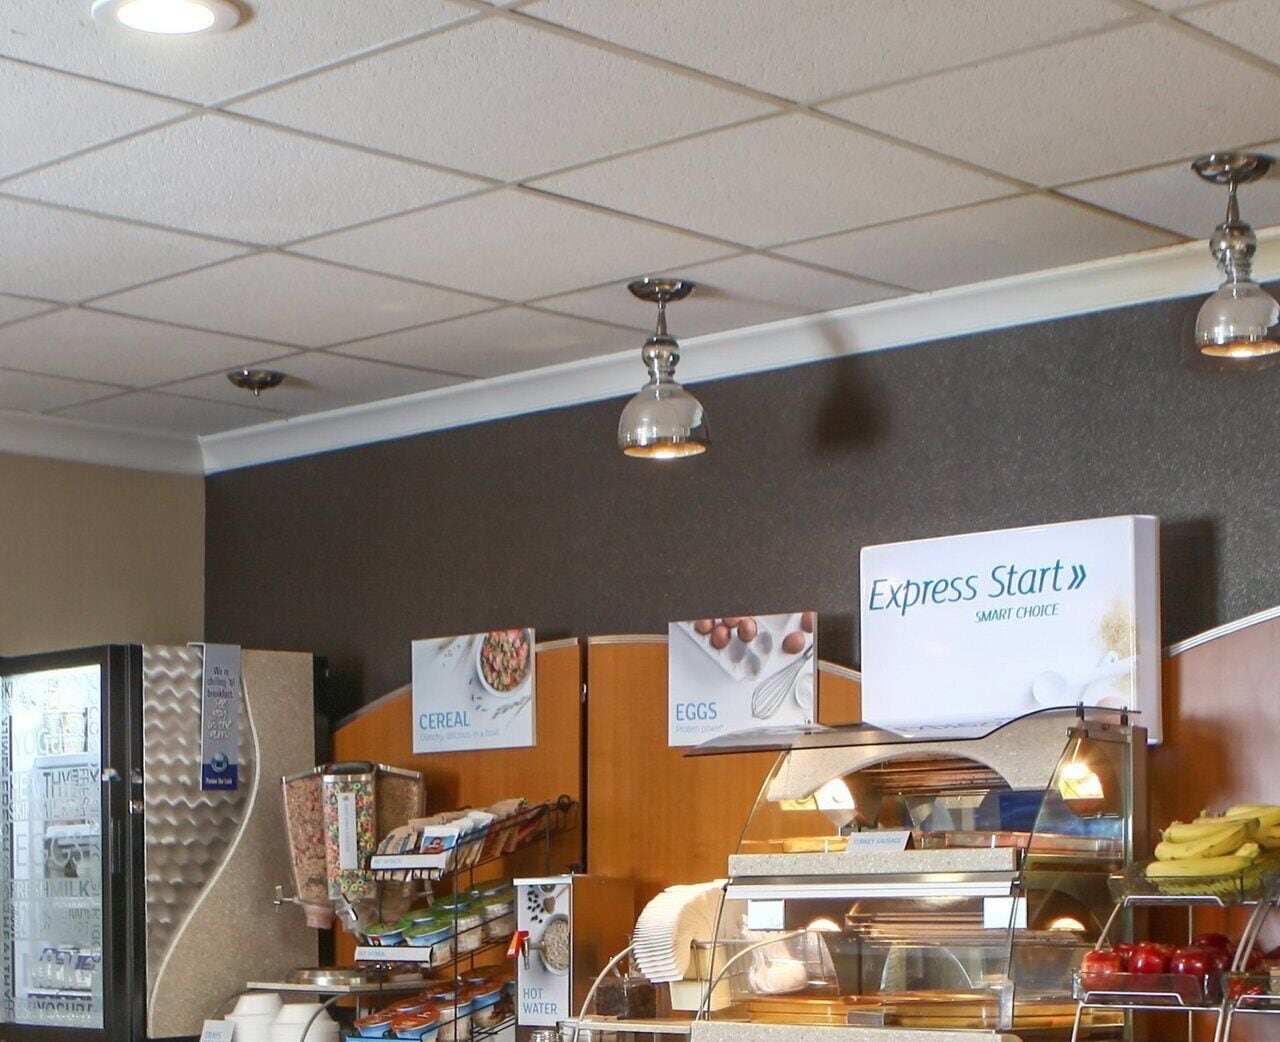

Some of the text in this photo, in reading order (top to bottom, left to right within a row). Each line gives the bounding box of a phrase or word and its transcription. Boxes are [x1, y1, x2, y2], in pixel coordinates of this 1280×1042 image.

[869, 559, 1064, 616] Express Start
[975, 603, 1060, 624] SMART CHOICE
[419, 711, 471, 730] CEREAL
[676, 702, 718, 721] EGGS
[523, 987, 544, 999] HOT
[523, 1002, 557, 1015] WATER
